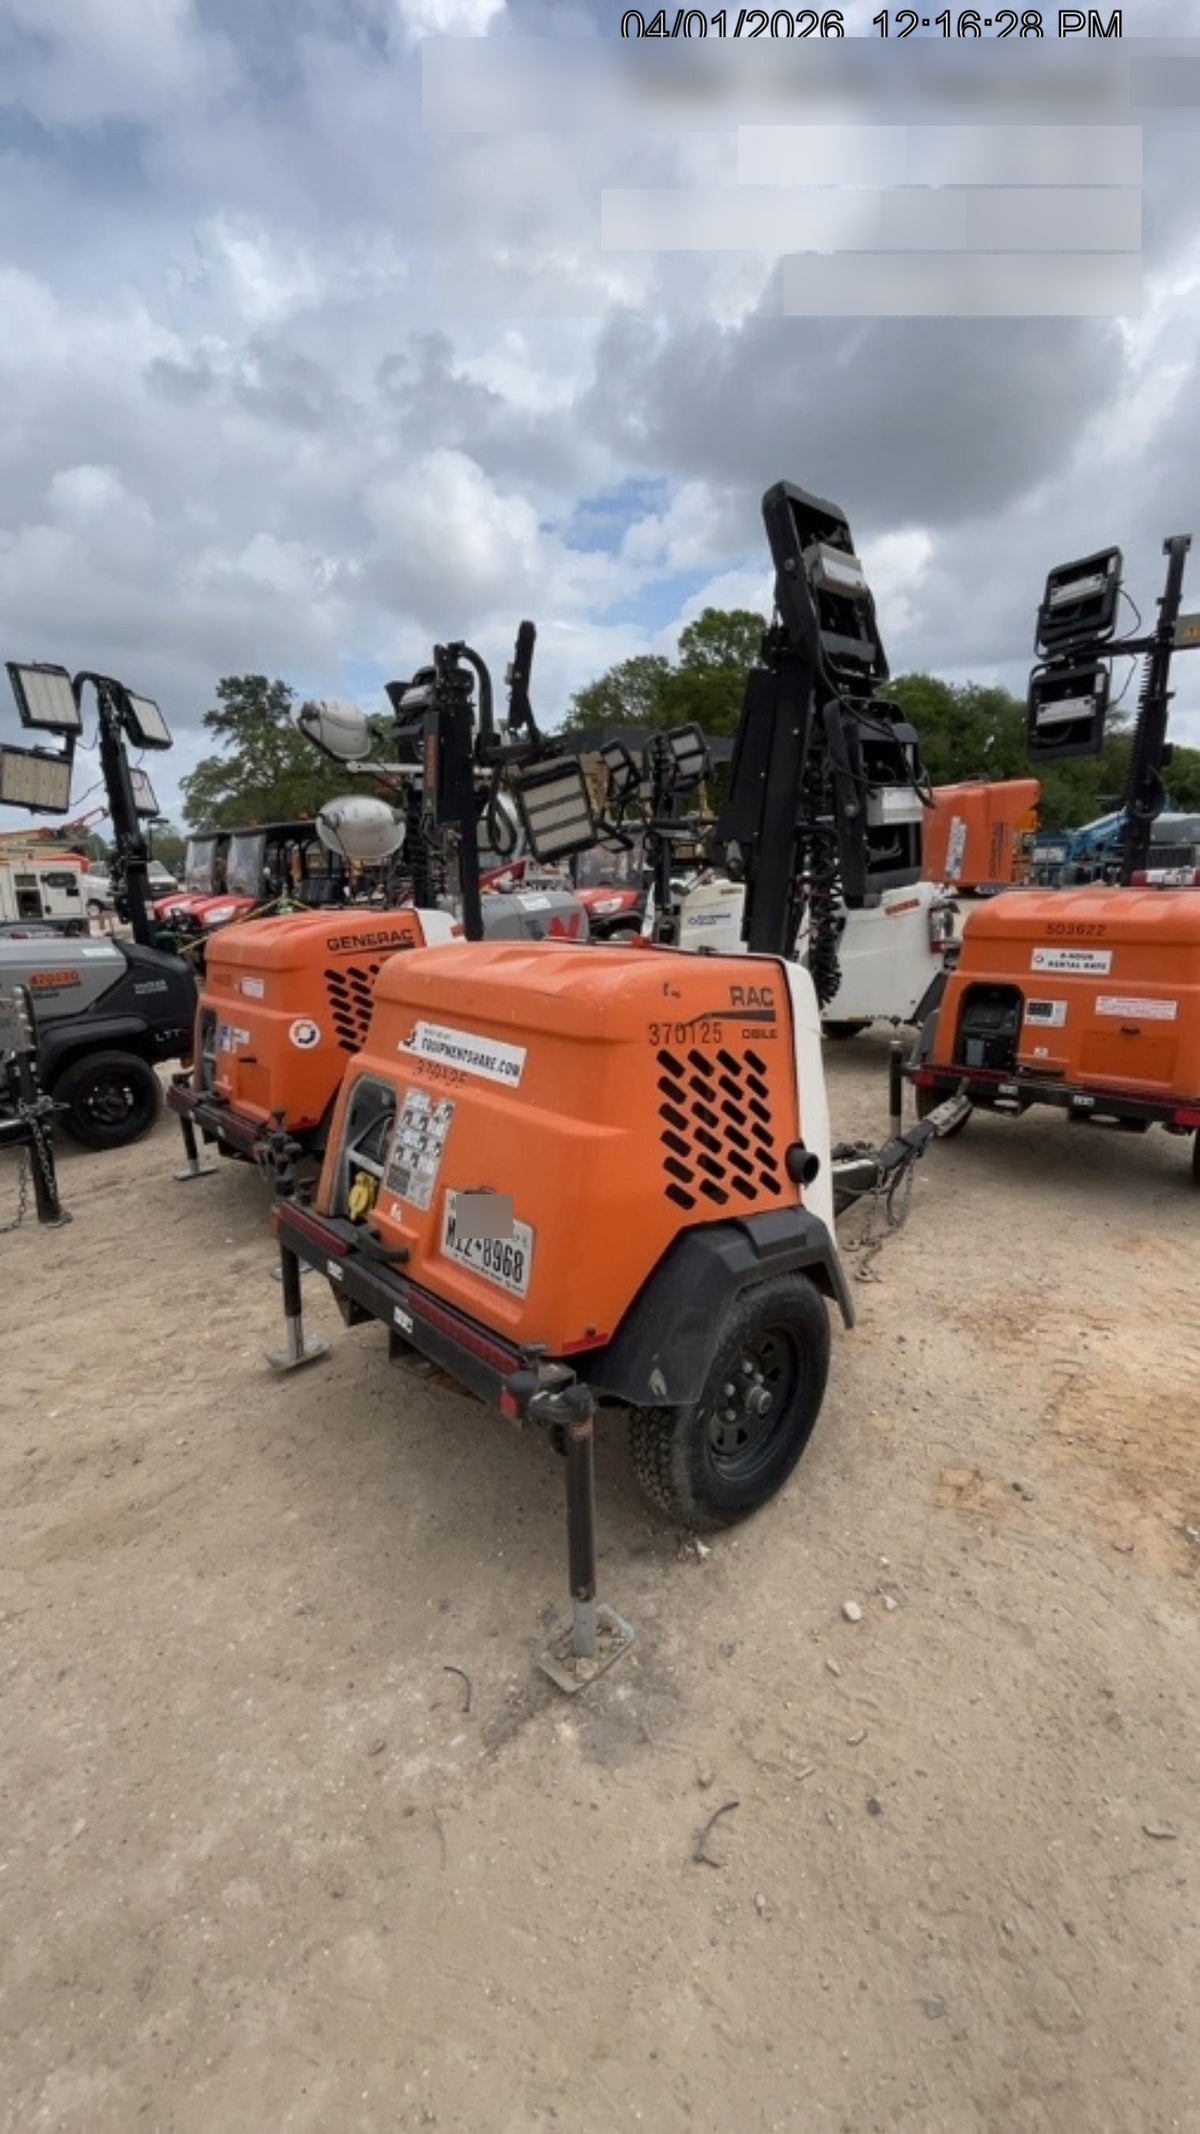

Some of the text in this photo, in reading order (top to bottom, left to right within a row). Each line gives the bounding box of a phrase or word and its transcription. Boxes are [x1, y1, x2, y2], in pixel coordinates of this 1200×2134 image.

[327, 929, 413, 950] GENERAC
[1046, 922, 1106, 936] 503622
[648, 1021, 722, 1046] 370125
